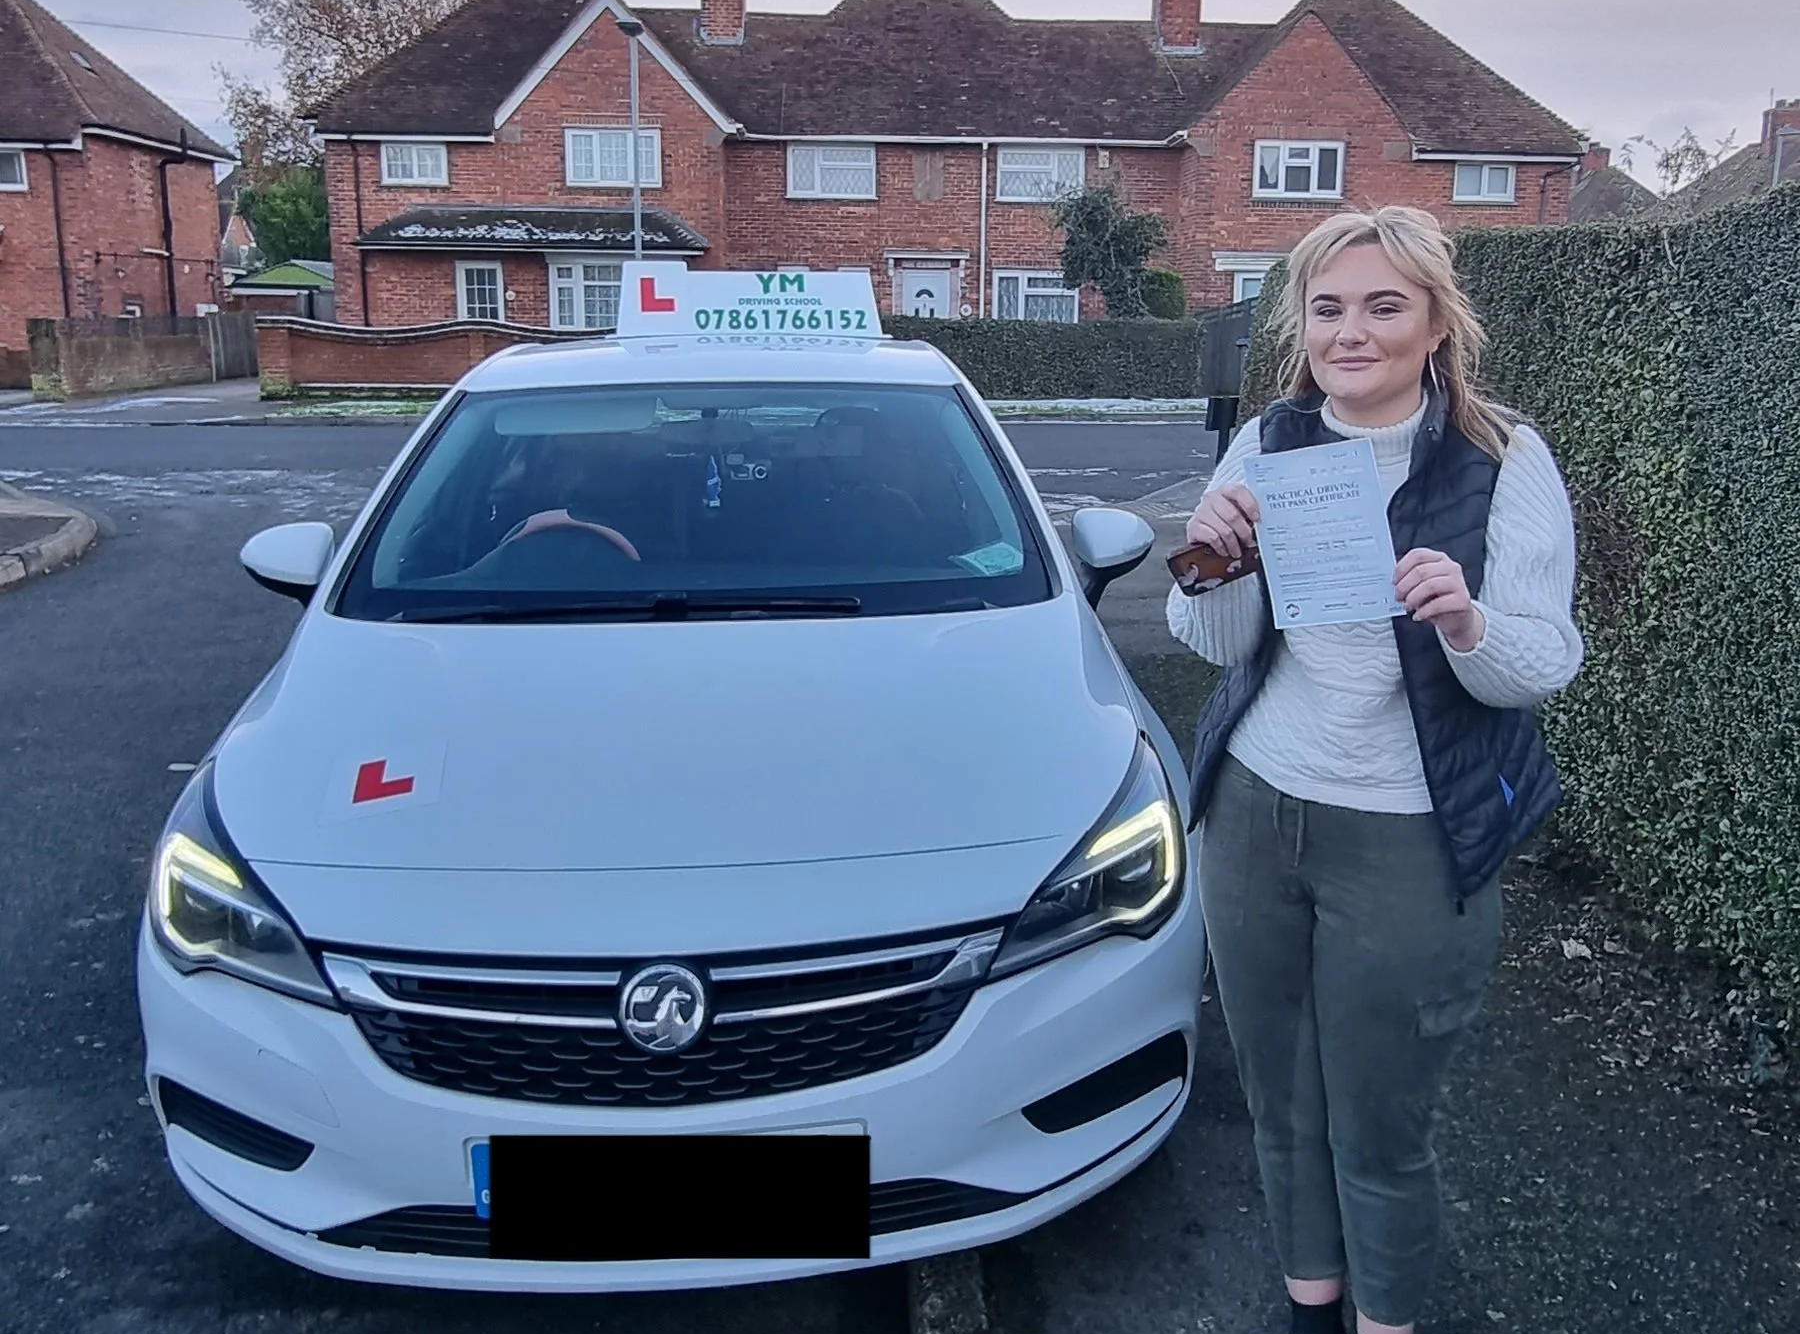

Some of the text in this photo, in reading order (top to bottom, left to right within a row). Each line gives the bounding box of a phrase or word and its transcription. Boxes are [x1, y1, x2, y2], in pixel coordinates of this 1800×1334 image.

[639, 277, 676, 313] L
[755, 273, 805, 295] YM
[738, 297, 823, 307] DRIVING SCHOOL
[694, 309, 868, 331] 07861766152
[1266, 481, 1360, 502] PRACTICAL DRIVING
[1288, 497, 1307, 509] PASS
[1308, 489, 1360, 505] CERTIFICATE
[352, 758, 415, 804] L
